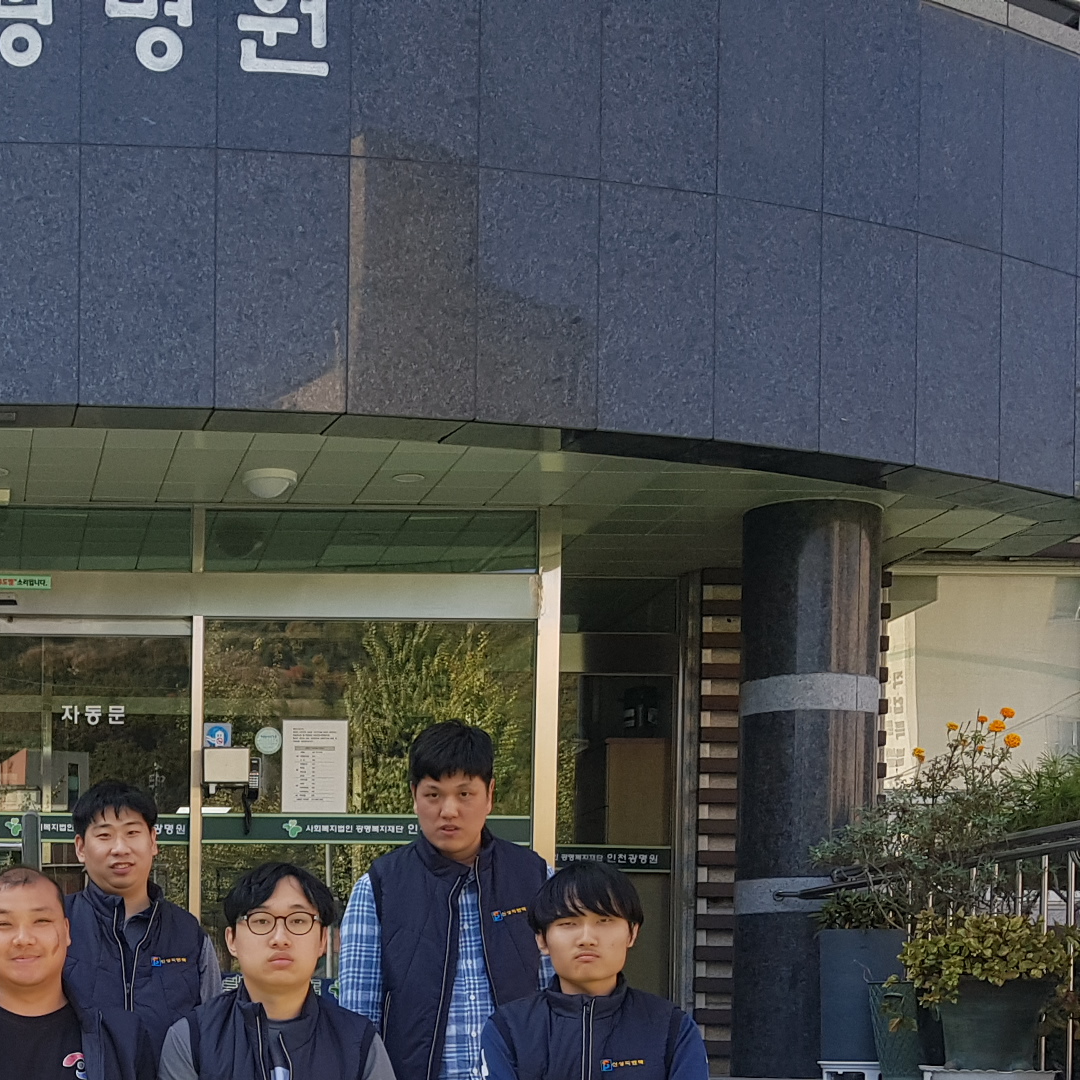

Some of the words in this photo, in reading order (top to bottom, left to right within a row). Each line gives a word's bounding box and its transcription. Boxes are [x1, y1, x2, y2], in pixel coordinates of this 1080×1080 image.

[61, 705, 126, 725] 자동문
[305, 824, 353, 833] 사회복지법인
[606, 853, 658, 864] 인천광명원
